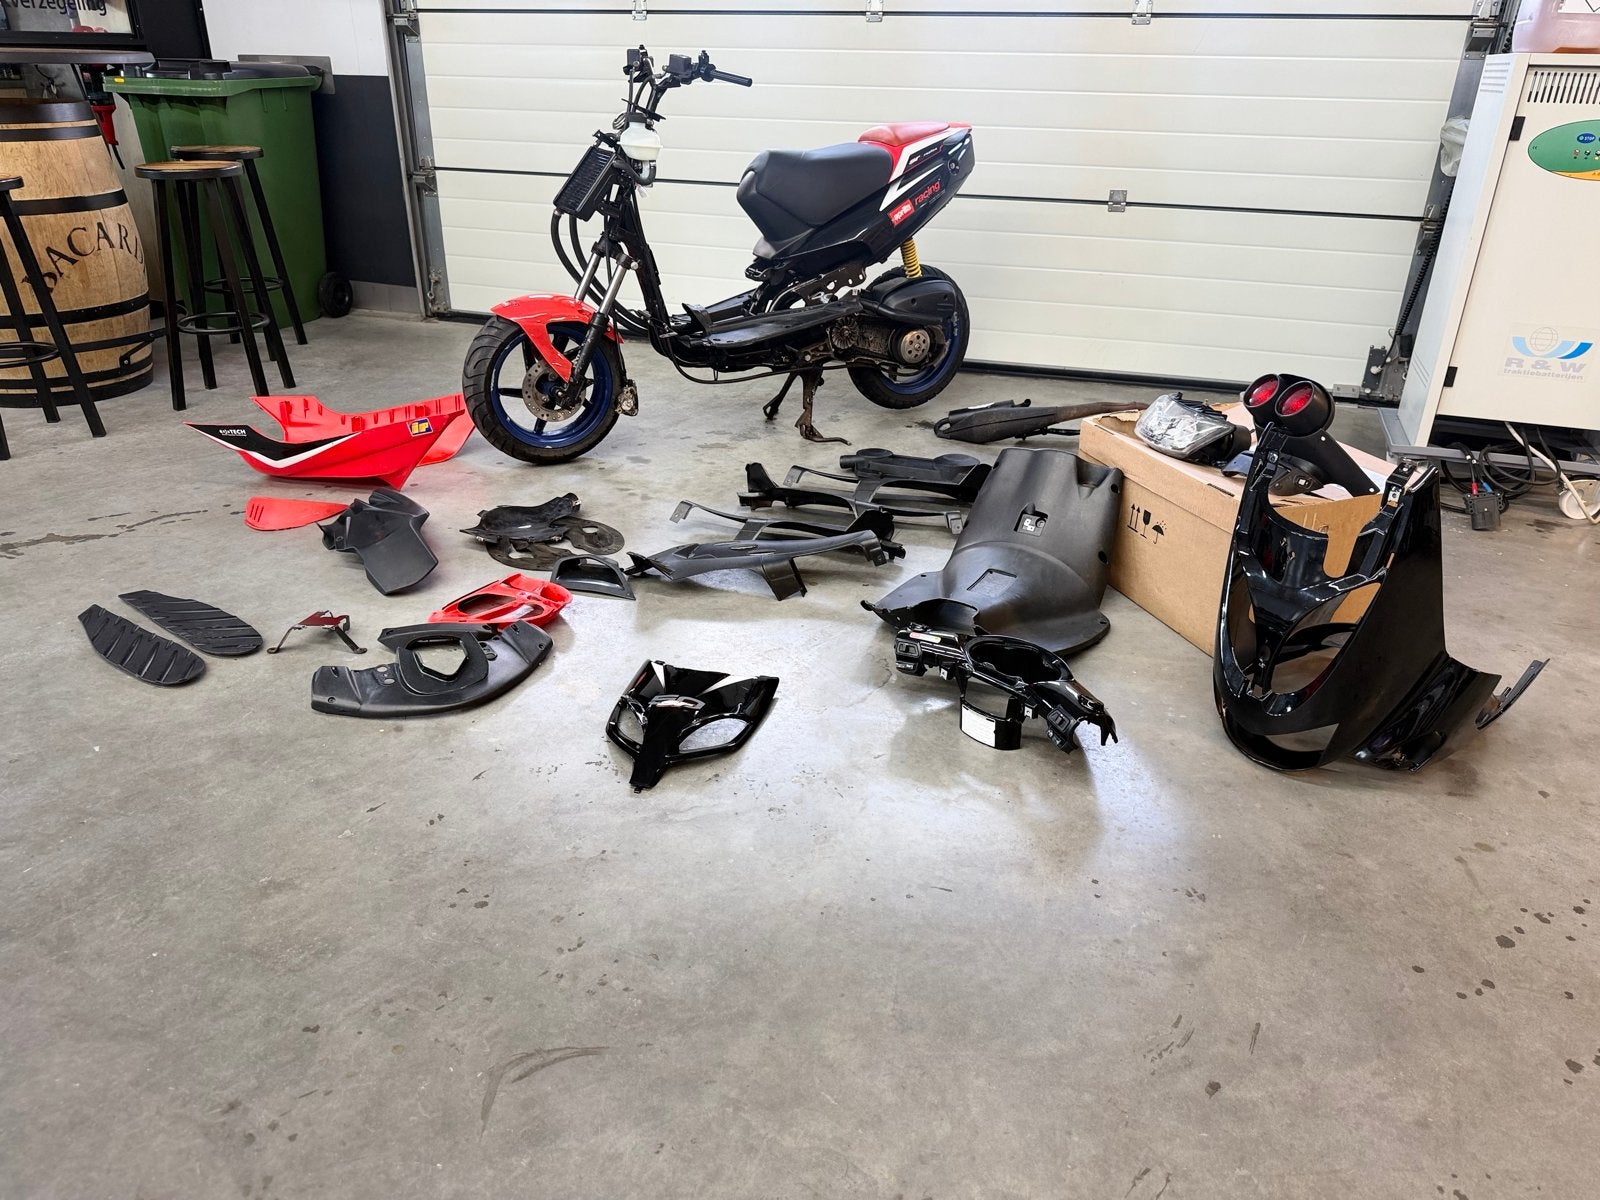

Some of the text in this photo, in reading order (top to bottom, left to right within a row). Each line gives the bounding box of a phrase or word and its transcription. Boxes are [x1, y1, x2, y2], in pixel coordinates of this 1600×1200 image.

[914, 181, 941, 205] racing
[1504, 357, 1587, 373] R & W
[1503, 368, 1584, 380] traktiebatterijen
